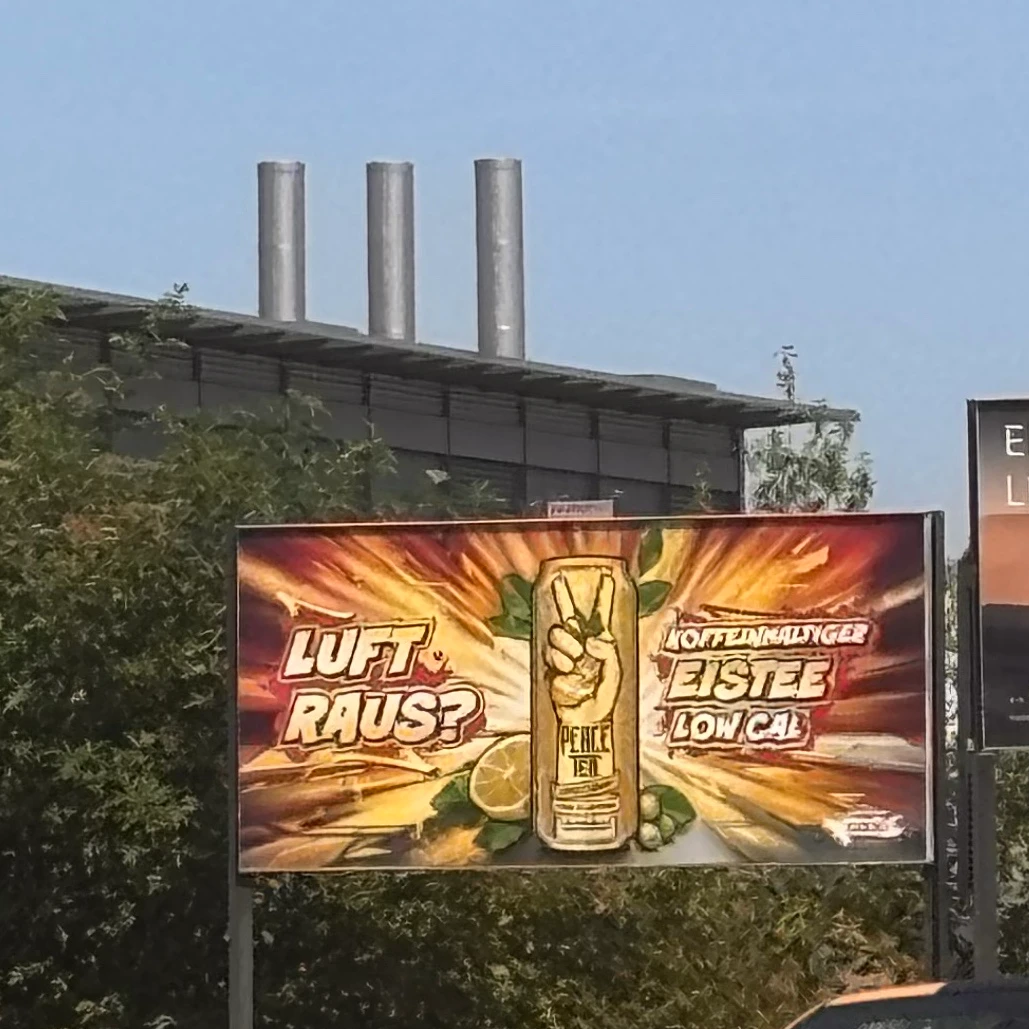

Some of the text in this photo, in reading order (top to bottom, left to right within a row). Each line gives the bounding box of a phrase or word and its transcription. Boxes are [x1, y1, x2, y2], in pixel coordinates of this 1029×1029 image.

[282, 623, 430, 678] LUFT
[667, 659, 832, 701] EISTEE
[283, 688, 480, 745] RAUS?
[671, 710, 742, 742] LOW
